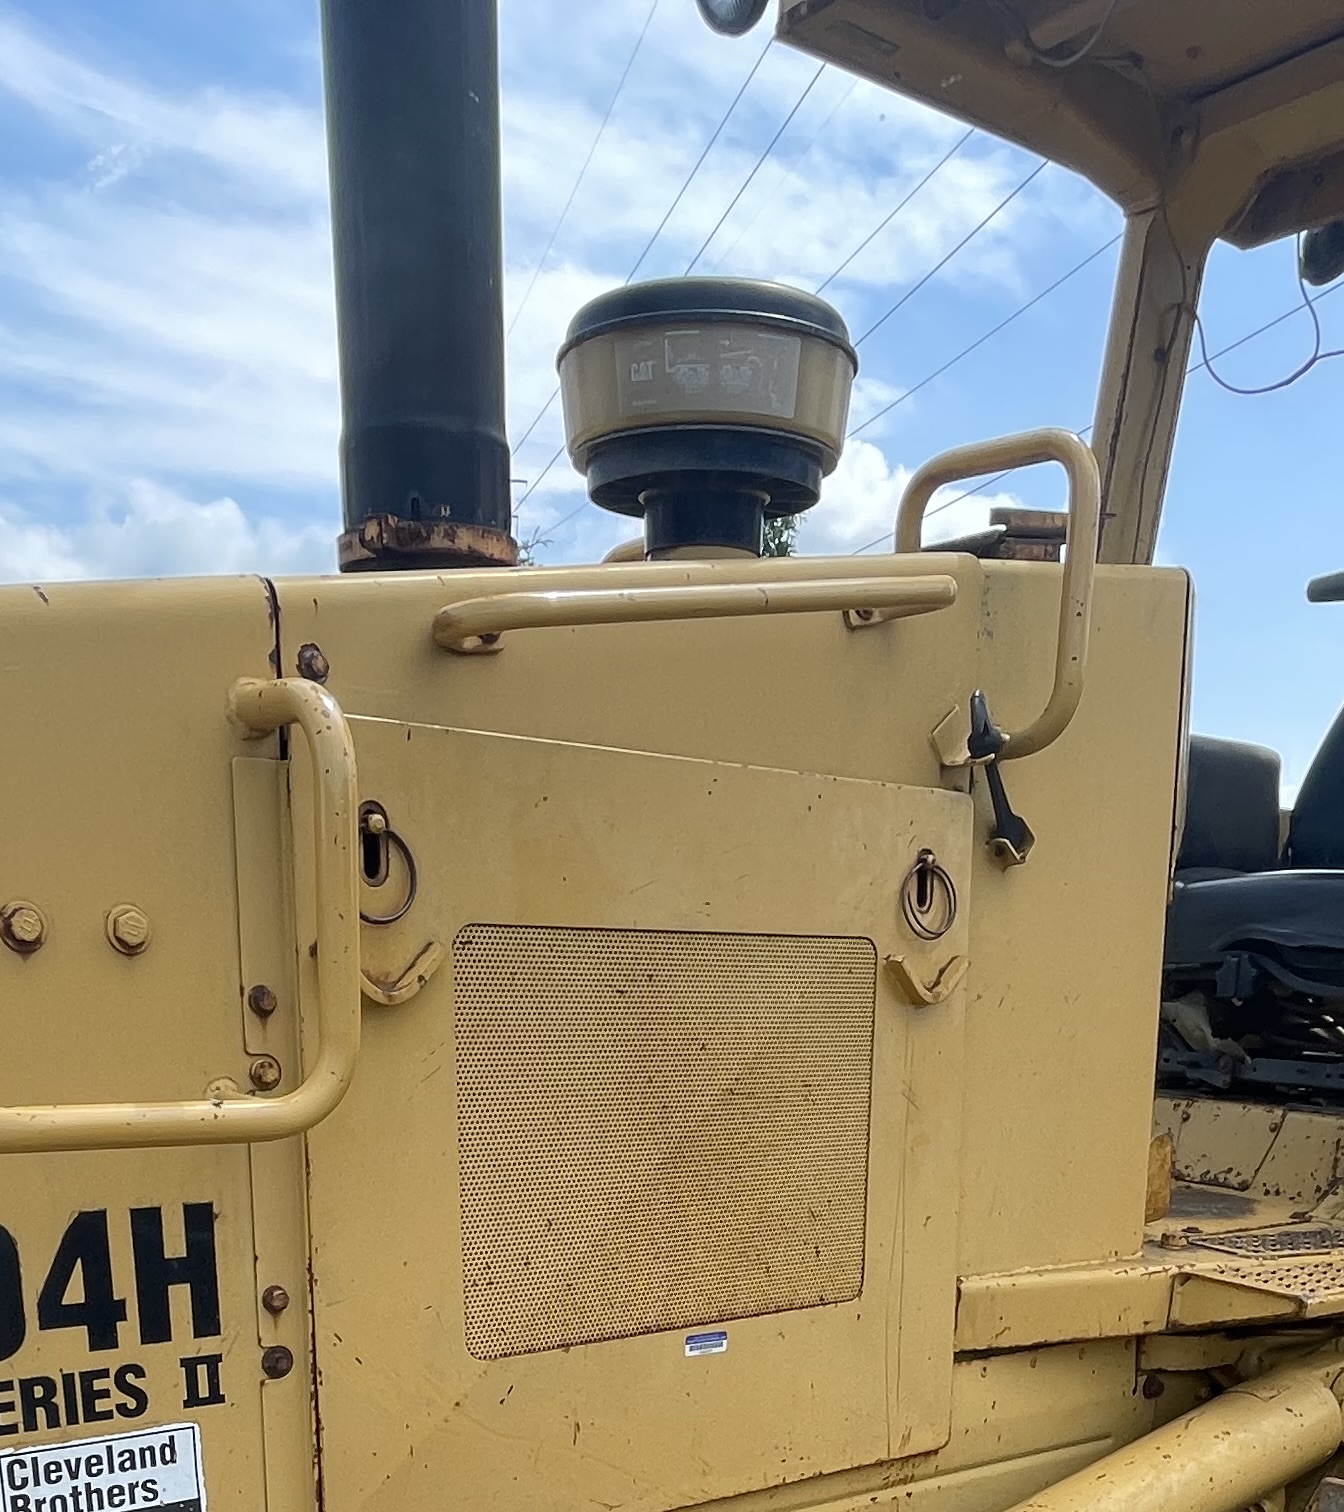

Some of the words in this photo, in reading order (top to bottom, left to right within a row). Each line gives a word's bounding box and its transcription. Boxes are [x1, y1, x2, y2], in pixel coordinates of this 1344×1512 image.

[630, 361, 657, 382] CAT
[180, 1353, 226, 1410] II
[6, 1435, 177, 1491] Cleveland
